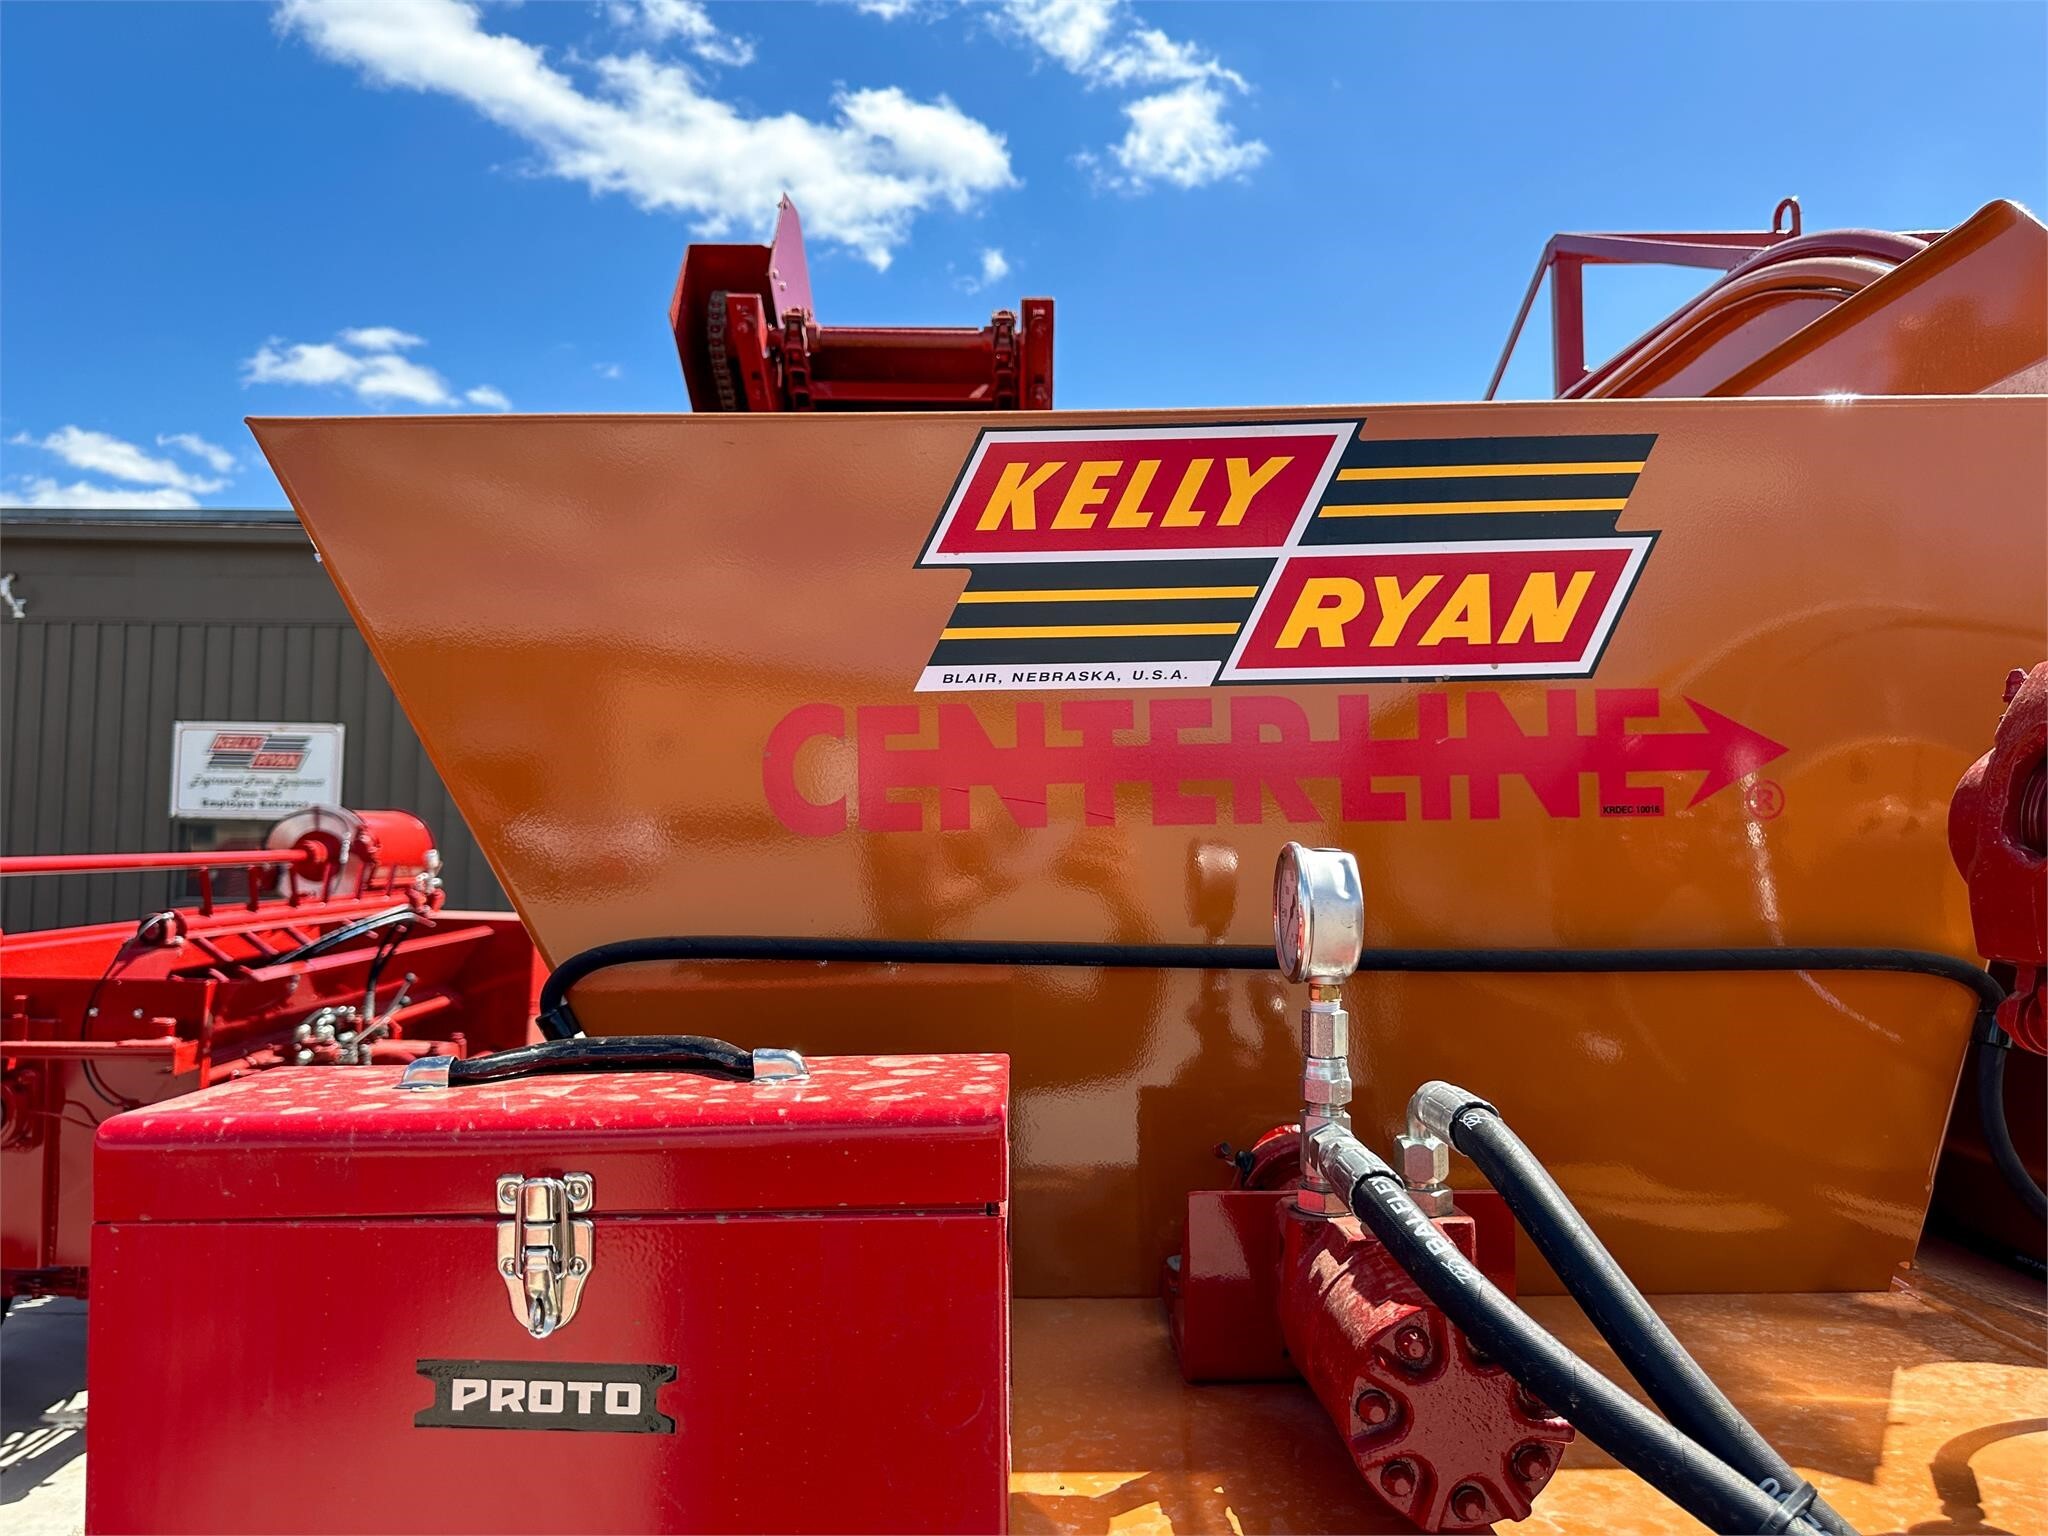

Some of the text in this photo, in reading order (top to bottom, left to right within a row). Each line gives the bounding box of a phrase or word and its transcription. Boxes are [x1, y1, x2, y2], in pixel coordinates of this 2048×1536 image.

[975, 456, 1295, 531] KELLY
[1275, 571, 1596, 649] RYAN
[942, 669, 1189, 684] BLAIR, NEBRASKA, U.S.A.
[762, 688, 1665, 837] CENTERLINE
[451, 1378, 642, 1416] PROTO
